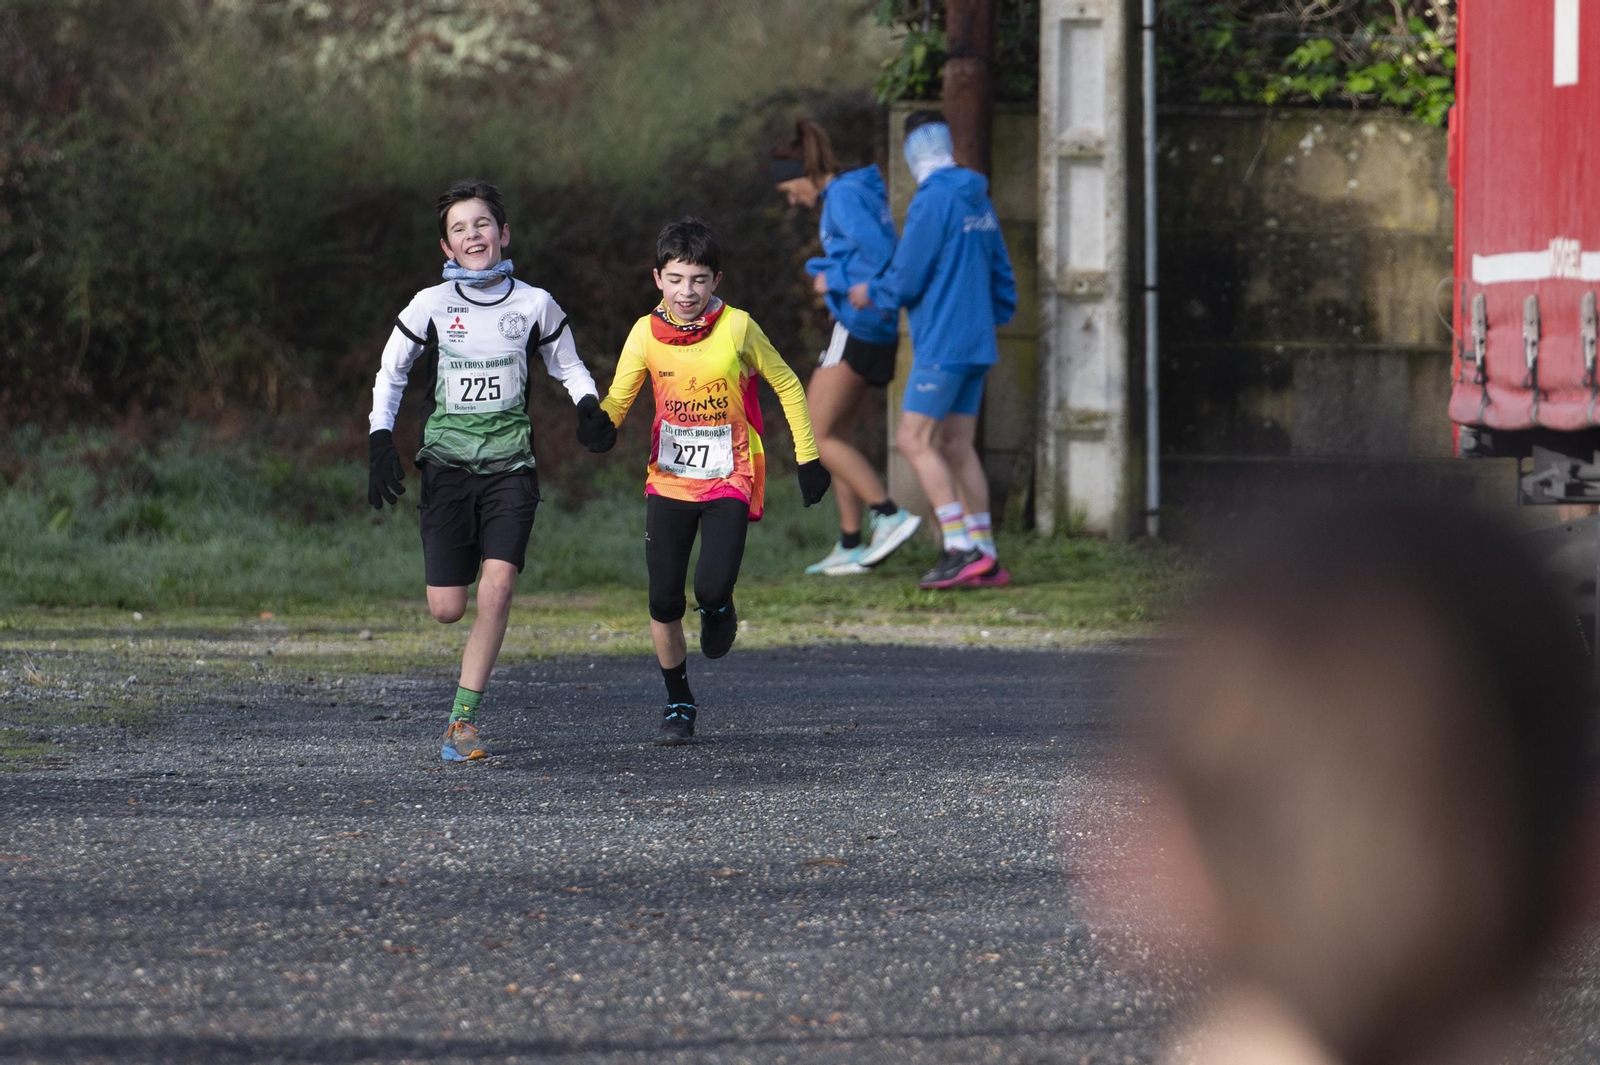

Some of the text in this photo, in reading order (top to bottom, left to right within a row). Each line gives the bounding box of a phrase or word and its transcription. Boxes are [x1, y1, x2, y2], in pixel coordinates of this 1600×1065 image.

[450, 361, 463, 369] XXV
[464, 361, 484, 369] CROSS
[460, 376, 501, 402] 225
[674, 428, 694, 437] CROSS
[672, 442, 709, 468] 227
